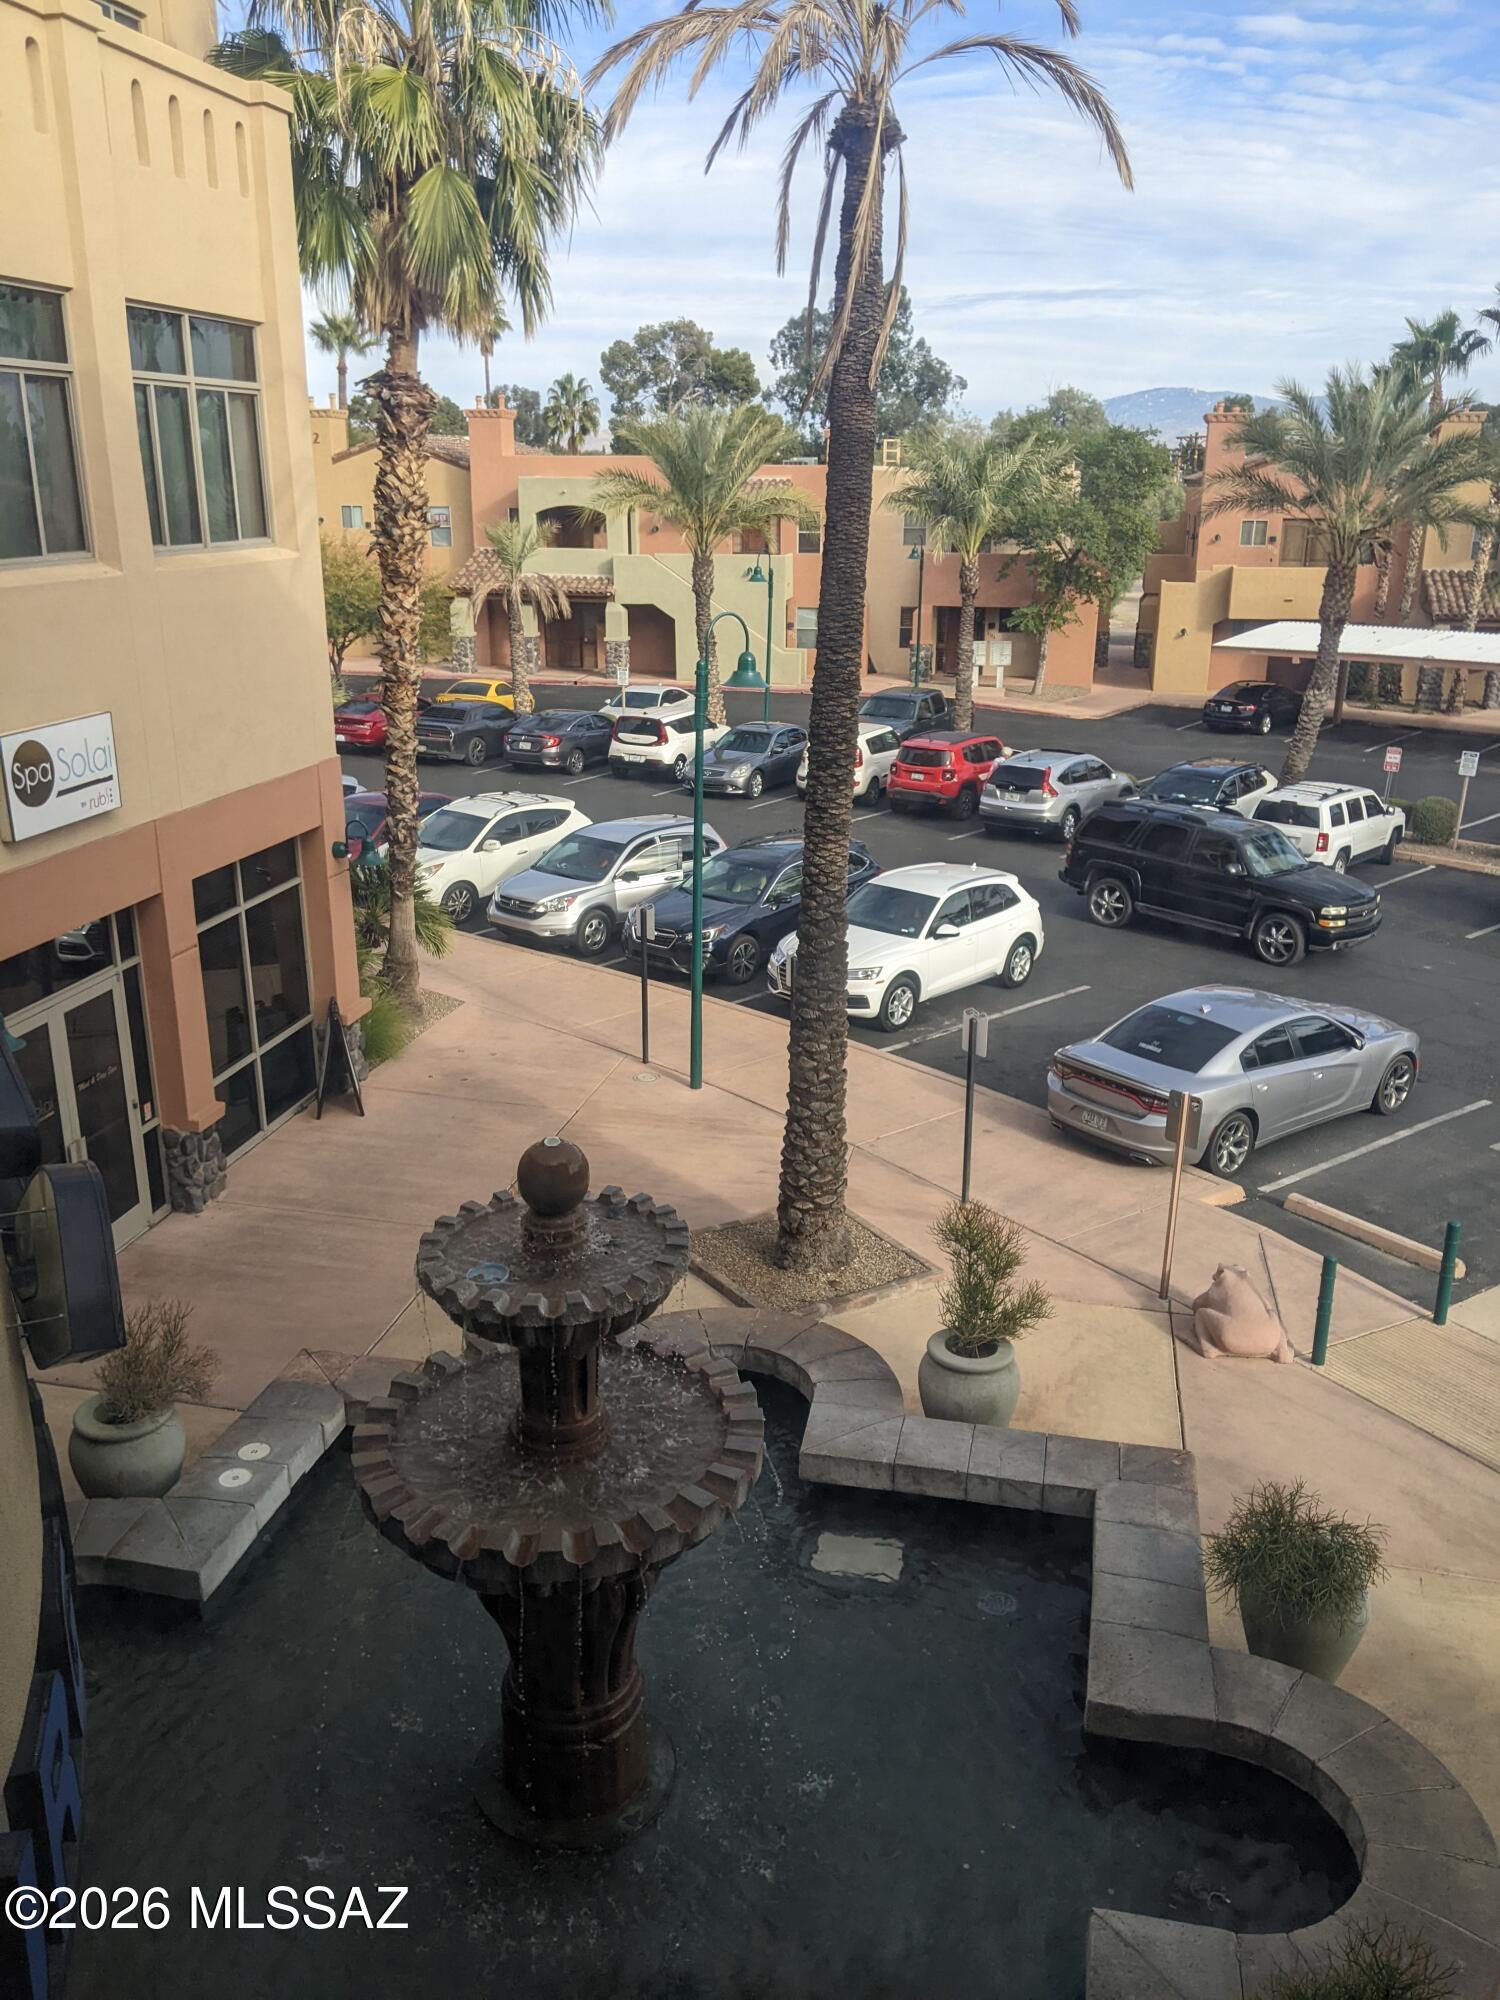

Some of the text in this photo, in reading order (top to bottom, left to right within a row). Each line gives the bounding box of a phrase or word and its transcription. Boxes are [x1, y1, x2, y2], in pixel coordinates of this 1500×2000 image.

[312, 432, 321, 444] 2
[13, 737, 112, 794] Spa Solai
